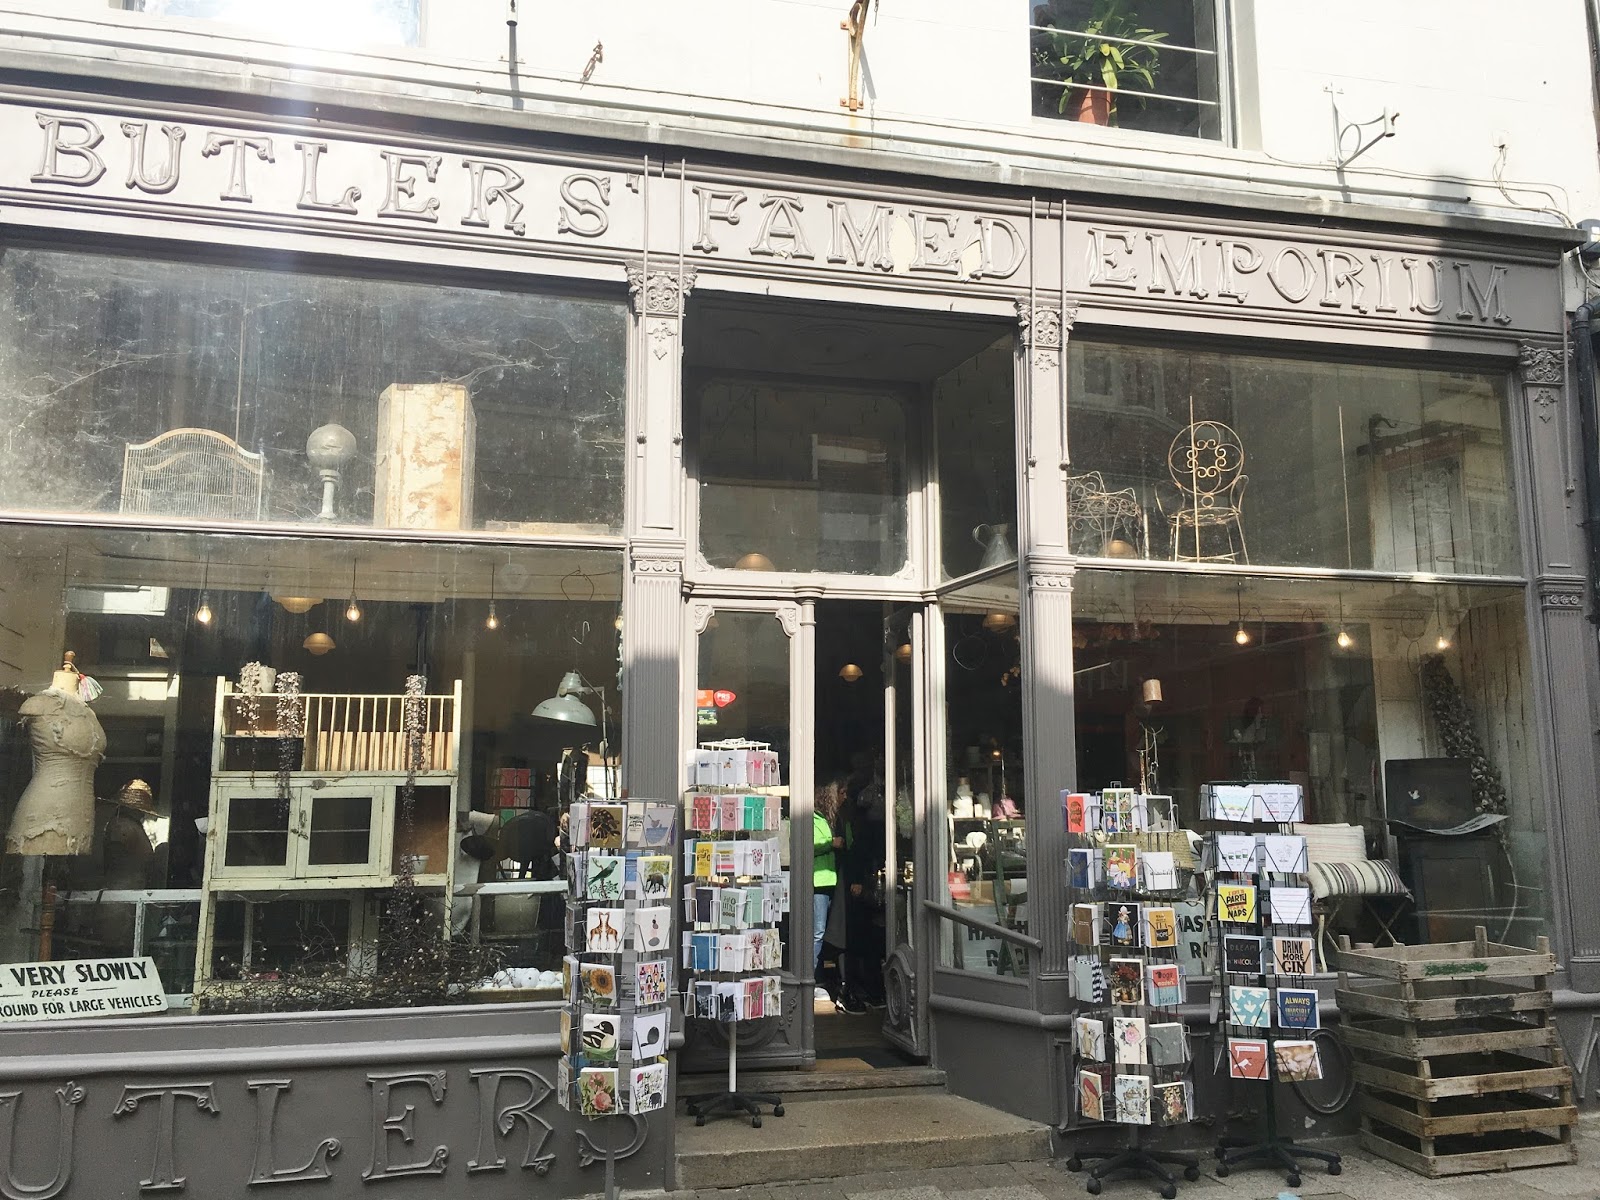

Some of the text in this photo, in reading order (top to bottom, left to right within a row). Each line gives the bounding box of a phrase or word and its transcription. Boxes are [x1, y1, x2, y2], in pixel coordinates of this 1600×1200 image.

[692, 185, 1028, 283] FAMED
[1087, 226, 1513, 326] EMPORIUM
[1226, 893, 1247, 905] PARTY
[1228, 908, 1247, 918] NAPS
[1282, 940, 1304, 954] DRINK
[1282, 953, 1304, 961] MORE
[1281, 961, 1307, 974] GIN
[9, 961, 147, 987] VERY SLOWLY
[31, 987, 79, 999] PLEASE
[42, 1001, 66, 1015] FOR
[69, 999, 106, 1013] LARGE
[109, 994, 162, 1010] VEHICLES
[1284, 996, 1311, 1006] ALWAYS
